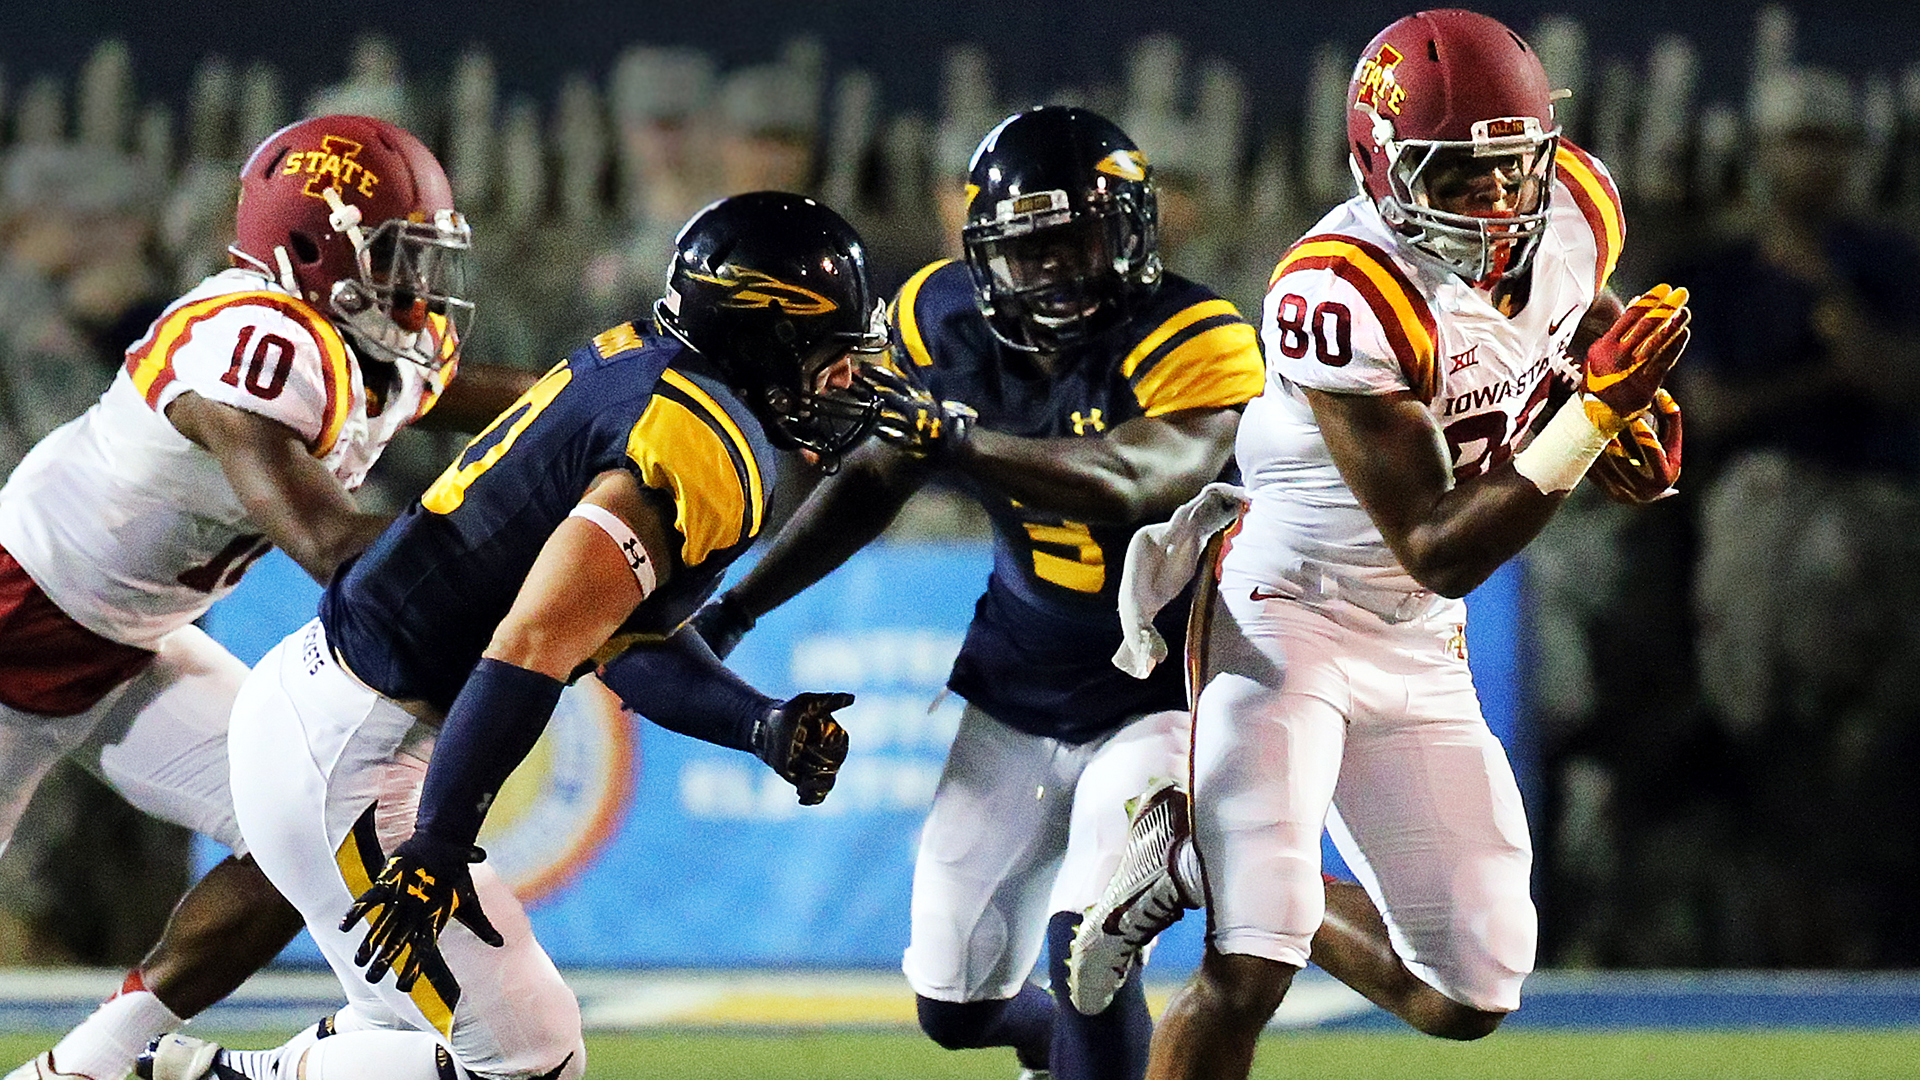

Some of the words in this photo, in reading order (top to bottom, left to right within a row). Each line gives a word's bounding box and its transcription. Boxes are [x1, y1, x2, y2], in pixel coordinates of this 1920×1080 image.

[1360, 60, 1406, 116] TATE
[282, 151, 379, 198] STATE
[1277, 292, 1352, 367] 80
[219, 324, 295, 400] 10
[1443, 380, 1512, 417] IOWA
